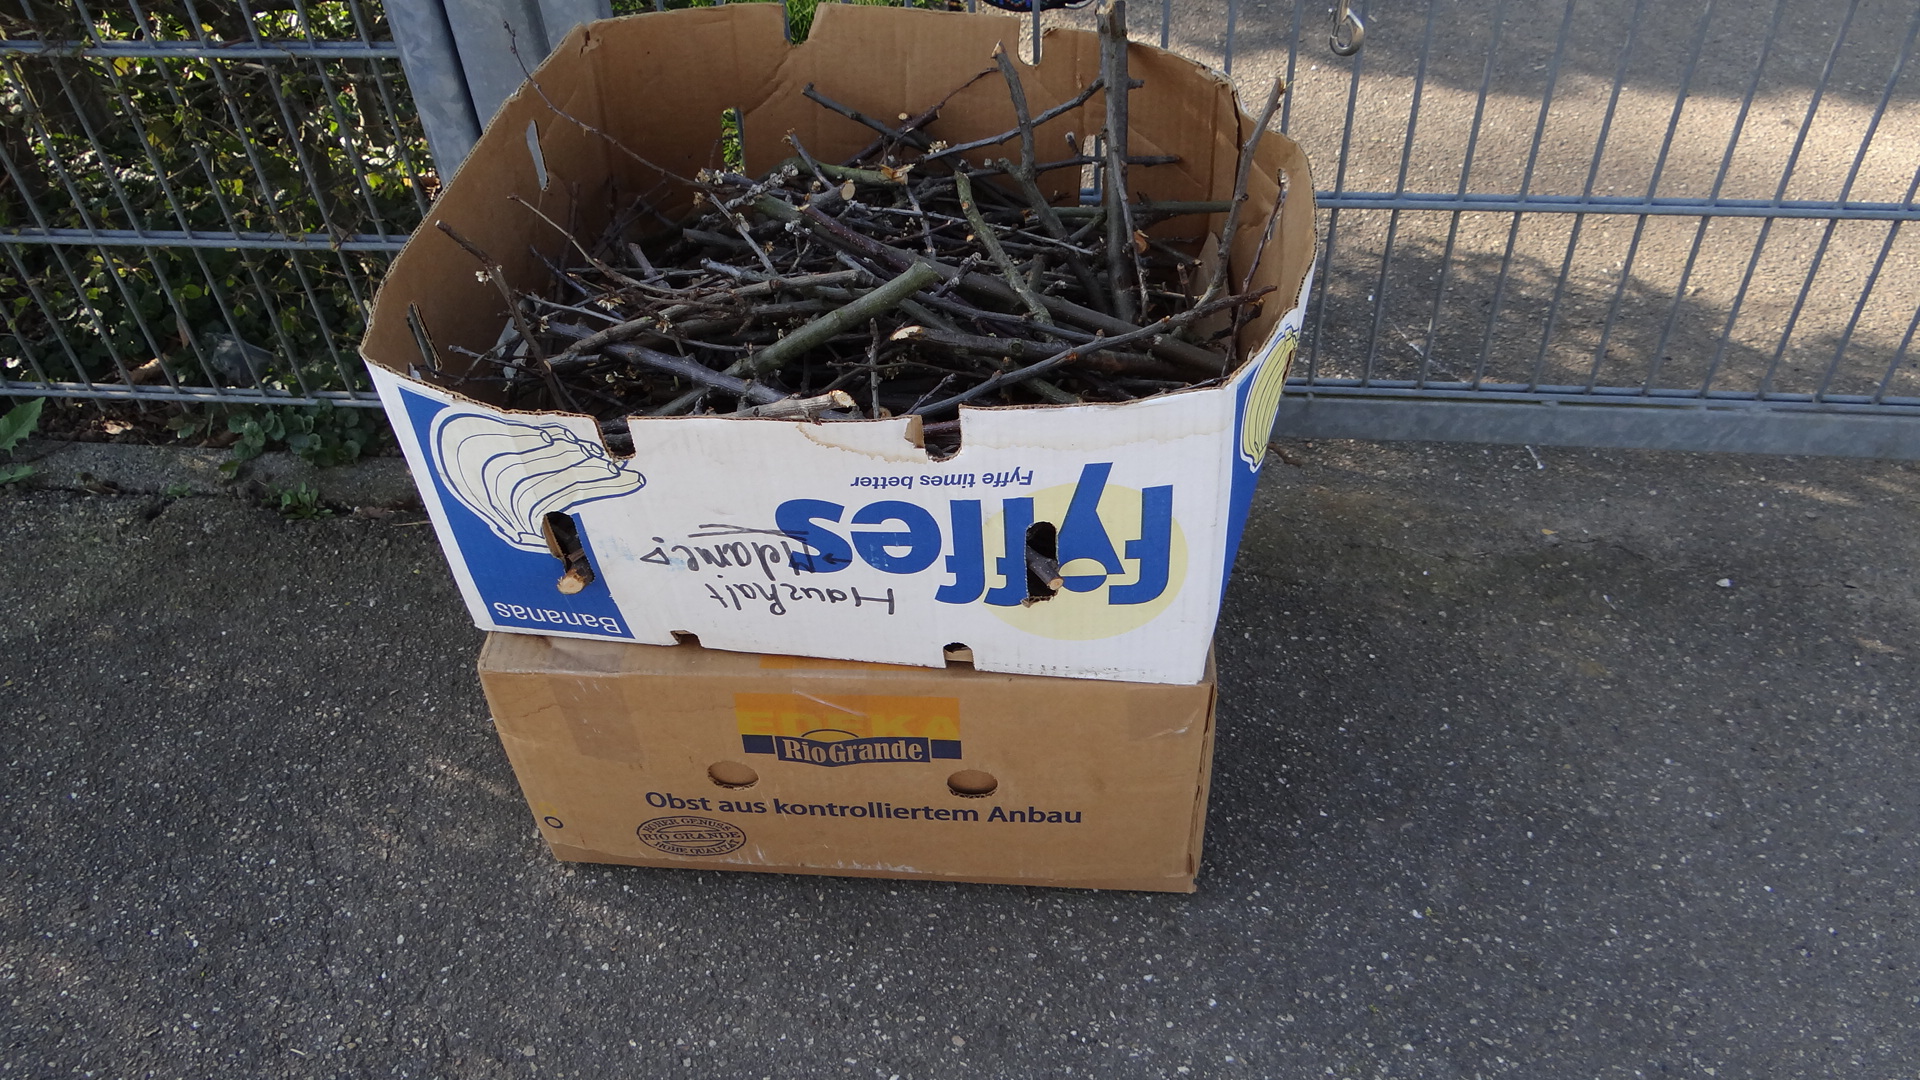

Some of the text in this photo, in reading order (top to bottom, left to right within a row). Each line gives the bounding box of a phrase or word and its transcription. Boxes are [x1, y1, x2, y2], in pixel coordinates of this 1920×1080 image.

[851, 469, 1033, 490] Fyffe times better
[775, 461, 1174, 606] fyffes
[704, 582, 896, 617] Haushalt
[493, 600, 622, 635] Bananas
[645, 791, 1082, 824] Obst aus kontrolliertem Anbau
[642, 817, 735, 834] HOHER GENUSS
[642, 831, 741, 841] RIO GRANDE
[653, 841, 690, 855] HOHE
